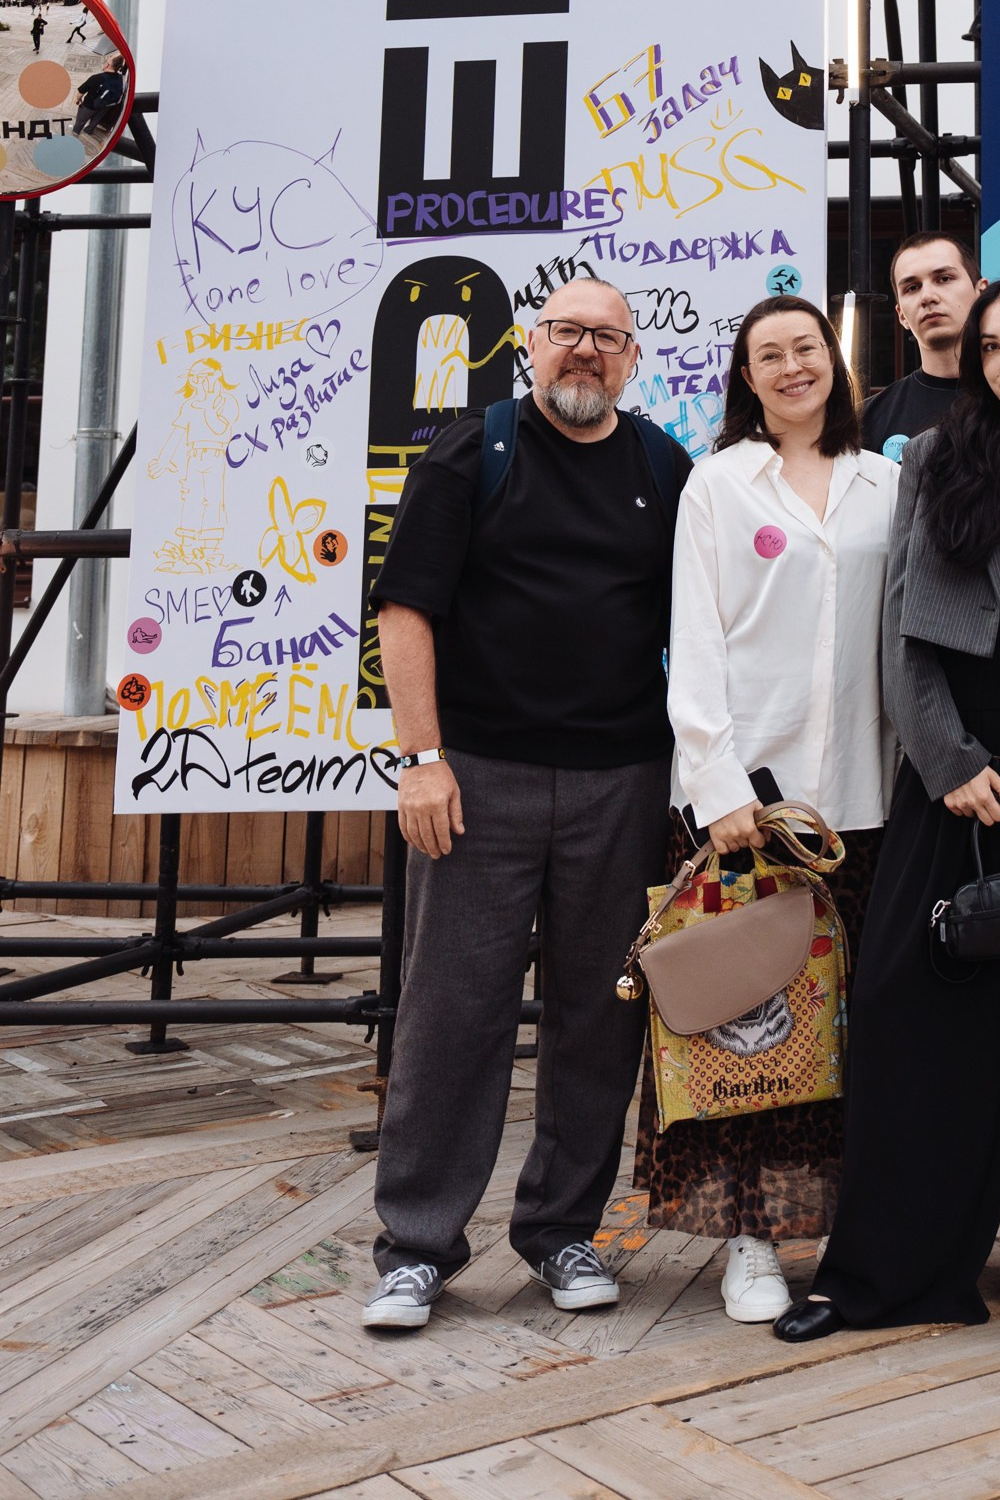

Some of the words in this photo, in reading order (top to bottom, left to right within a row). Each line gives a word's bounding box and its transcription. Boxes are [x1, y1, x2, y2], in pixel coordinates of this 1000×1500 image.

[638, 55, 742, 144] задач
[0, 118, 73, 140] НДТ
[386, 188, 627, 233] PROCEDURES
[206, 278, 266, 312] one
[286, 258, 362, 297] love
[246, 357, 316, 411] Лиза
[270, 349, 369, 450] развитие
[144, 586, 211, 625] SME
[211, 612, 359, 668] Банан
[131, 726, 231, 800] 2D
[234, 736, 366, 795] team
[712, 1075, 790, 1102] Garden
